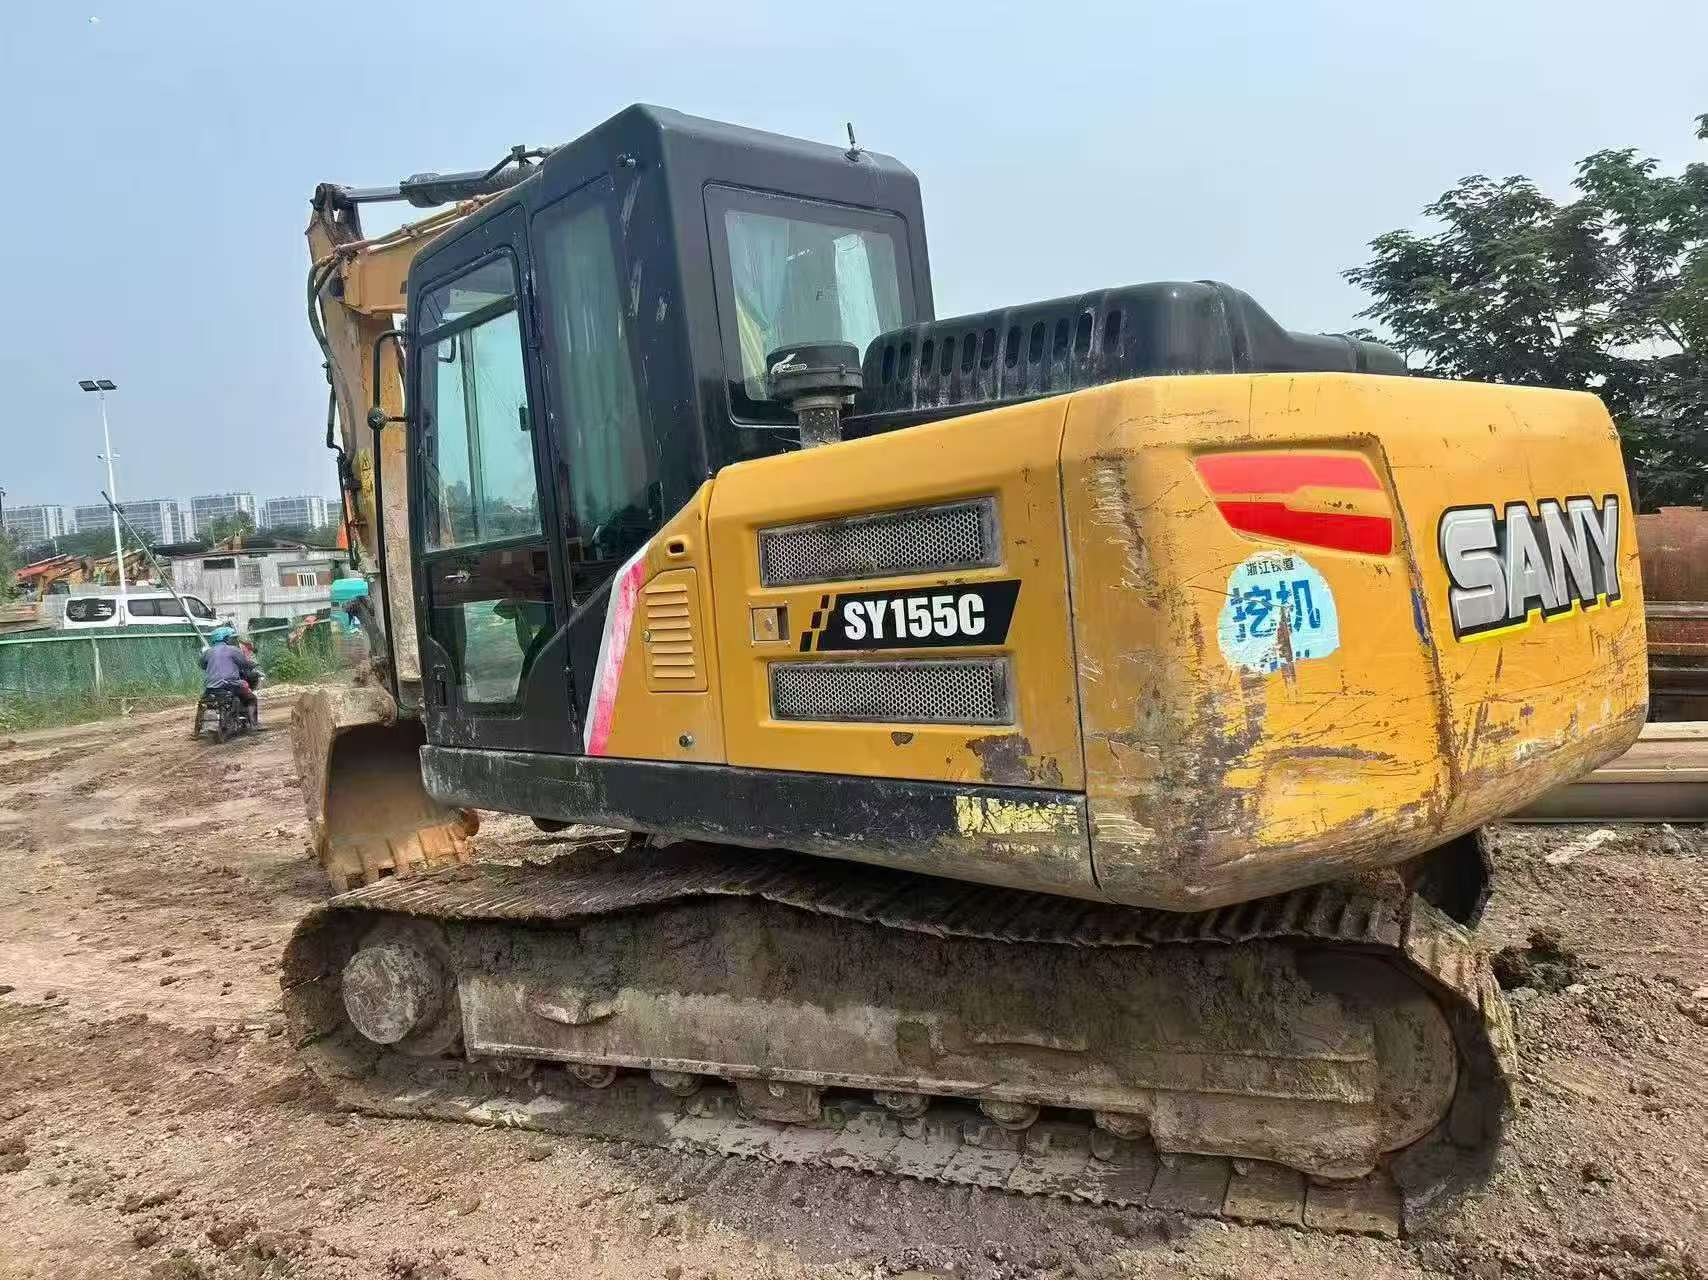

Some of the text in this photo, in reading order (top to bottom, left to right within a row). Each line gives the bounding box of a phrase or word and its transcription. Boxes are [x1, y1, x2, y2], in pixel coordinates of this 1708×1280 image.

[1438, 496, 1620, 636] SANY
[843, 593, 985, 640] SY155C
[1230, 580, 1321, 643] 挖机
